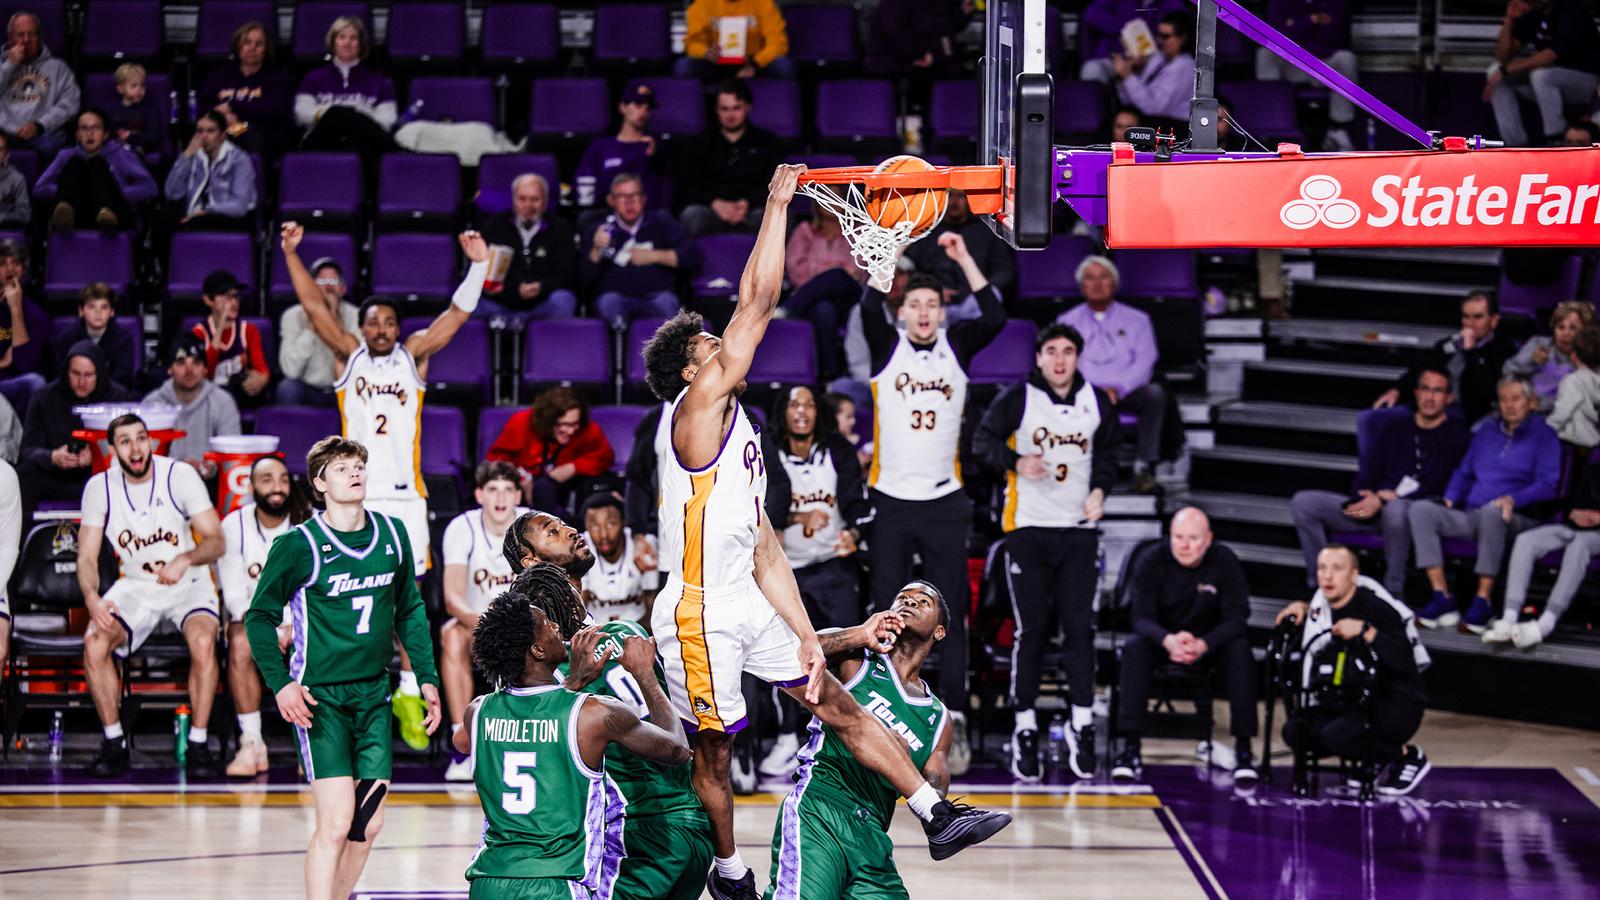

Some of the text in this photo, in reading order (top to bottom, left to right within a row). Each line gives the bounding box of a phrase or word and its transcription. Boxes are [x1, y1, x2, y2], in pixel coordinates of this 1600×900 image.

[1366, 173, 1600, 228] State Far
[375, 413, 388, 436] 2
[911, 409, 936, 431] 33
[743, 440, 764, 487] Pi
[1055, 463, 1068, 482] 3
[118, 528, 179, 557] Pirates
[326, 571, 396, 597] TULANE
[351, 595, 374, 635] 7
[484, 717, 559, 743] MIDDLETON
[501, 751, 537, 815] 5
